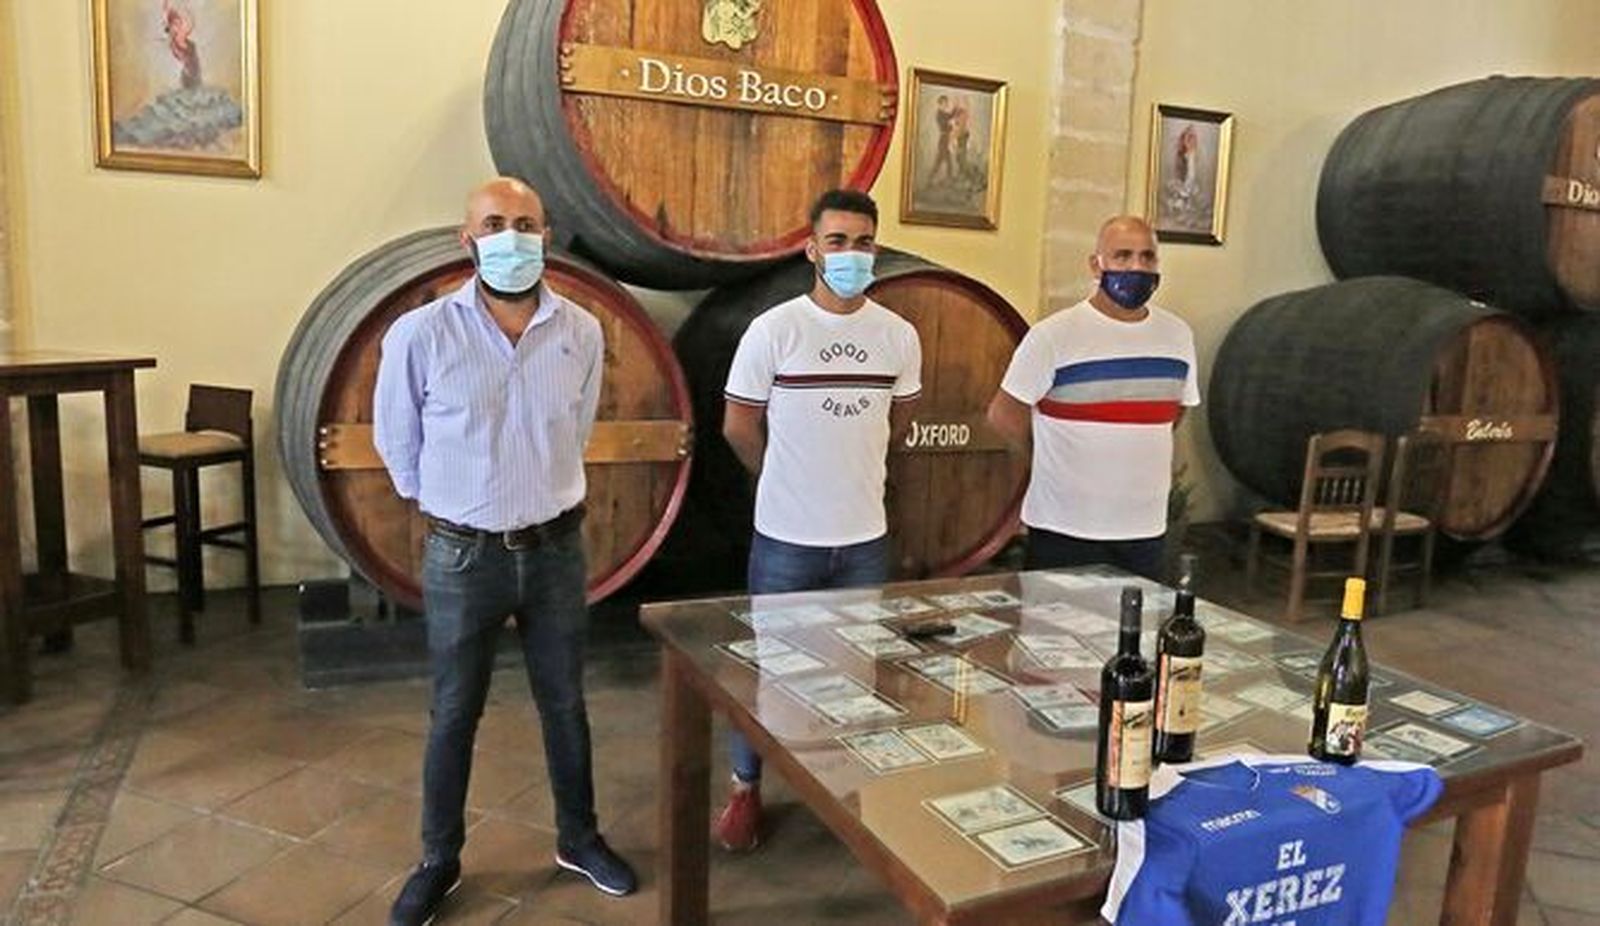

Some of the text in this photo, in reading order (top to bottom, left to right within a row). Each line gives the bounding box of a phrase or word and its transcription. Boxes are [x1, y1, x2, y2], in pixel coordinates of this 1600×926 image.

[638, 57, 827, 110] Dios Baco
[1568, 180, 1600, 206] Dio
[820, 342, 868, 363] GOOD
[822, 396, 870, 417] DEALS
[1277, 839, 1307, 870] EL
[1223, 863, 1346, 926] XEREZ
